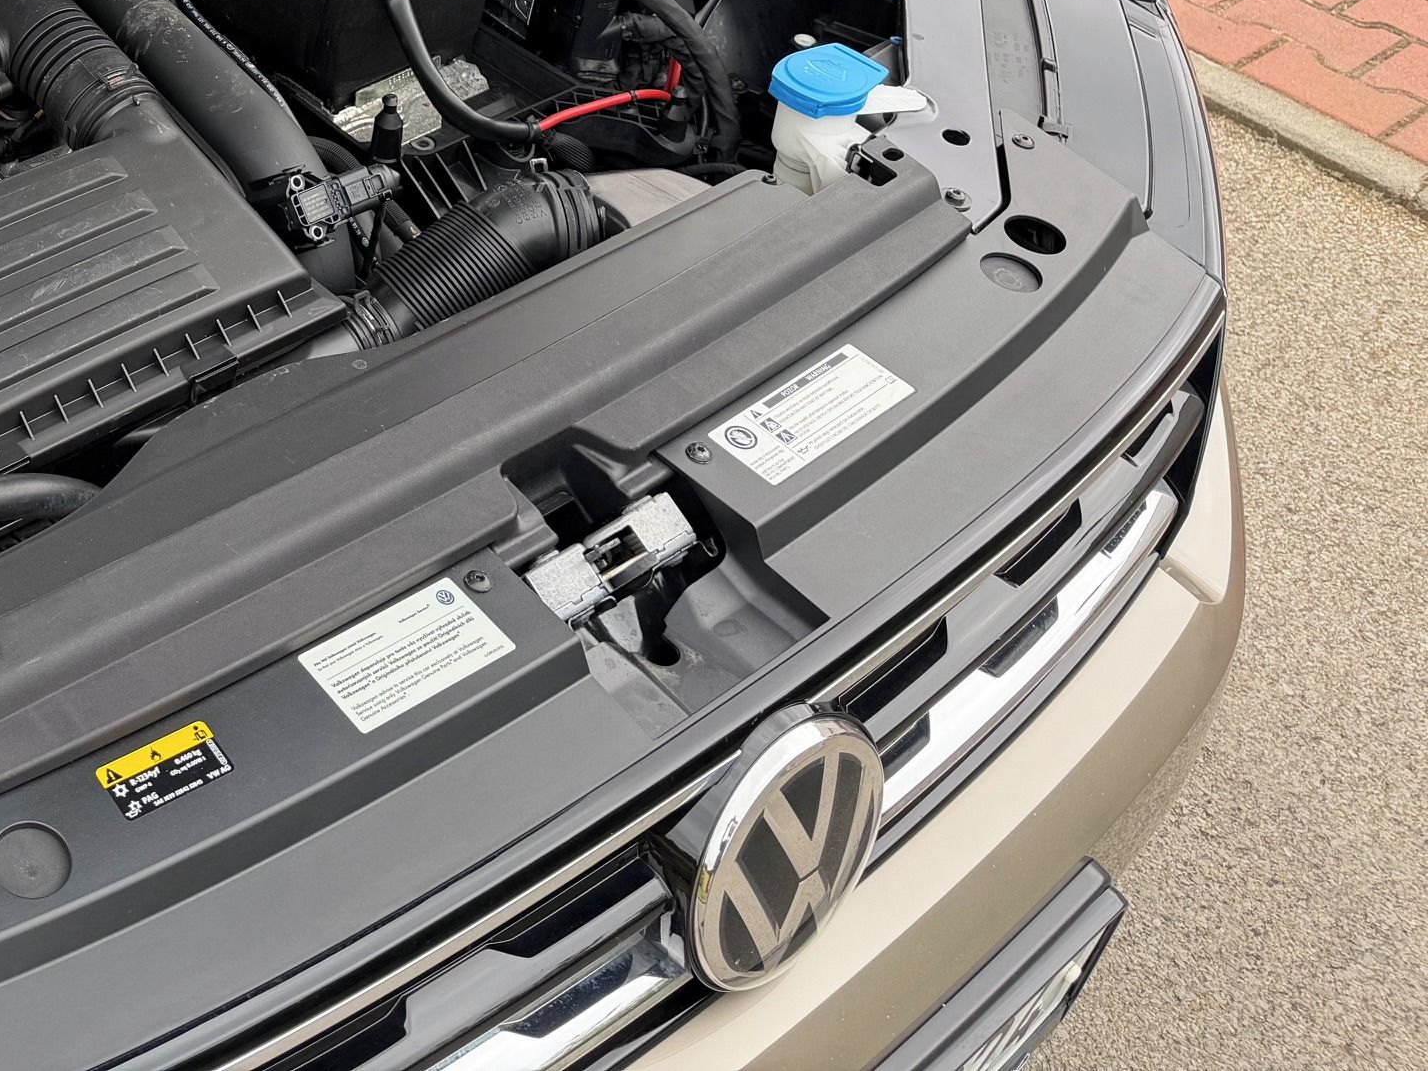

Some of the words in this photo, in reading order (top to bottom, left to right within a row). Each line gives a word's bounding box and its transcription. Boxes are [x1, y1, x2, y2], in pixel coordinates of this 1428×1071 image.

[781, 384, 800, 397] POZOR
[805, 364, 831, 380] WARNING
[331, 672, 360, 687] Volkswagen
[130, 767, 160, 786] R-1234yf
[207, 769, 220, 779] VW
[220, 764, 231, 774] AG
[142, 792, 159, 804] PAG
